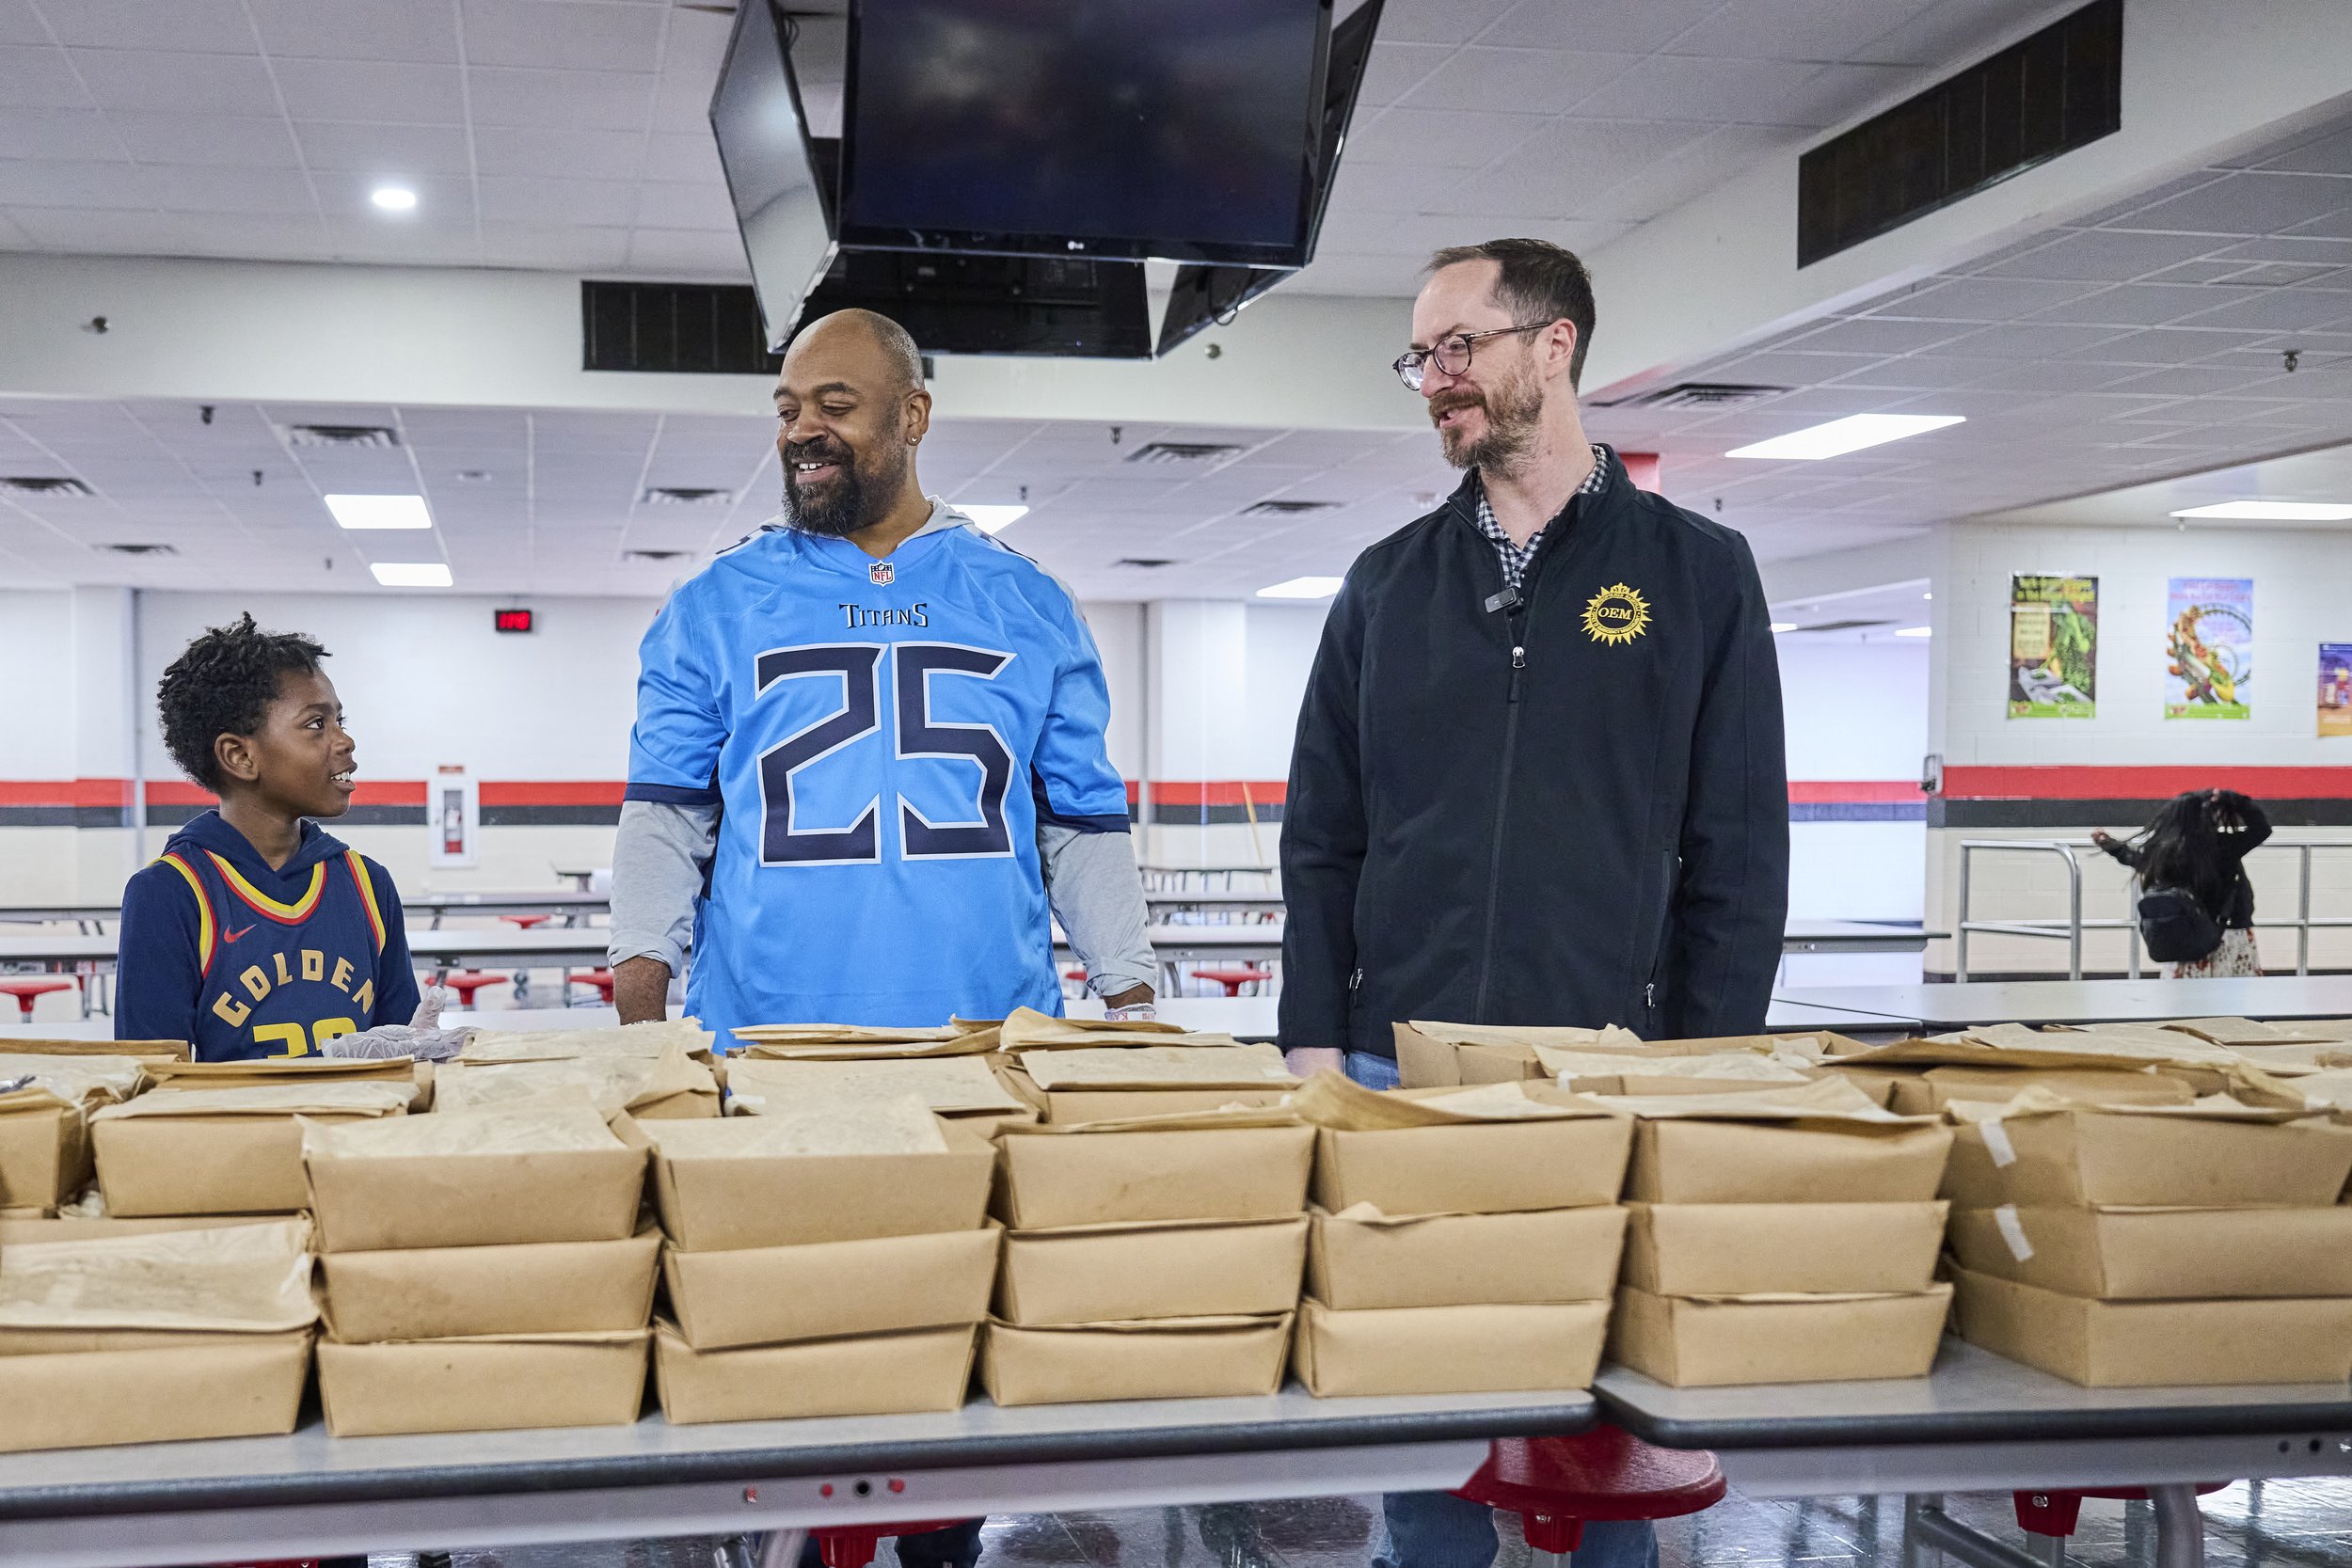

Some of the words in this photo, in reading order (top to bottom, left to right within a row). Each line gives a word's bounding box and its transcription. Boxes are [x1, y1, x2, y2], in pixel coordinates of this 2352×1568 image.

[873, 571, 892, 581] NFL
[839, 603, 928, 628] TITANS
[1597, 607, 1633, 621] OEM
[754, 641, 1018, 868] 25
[212, 949, 374, 1027] GOLDEN
